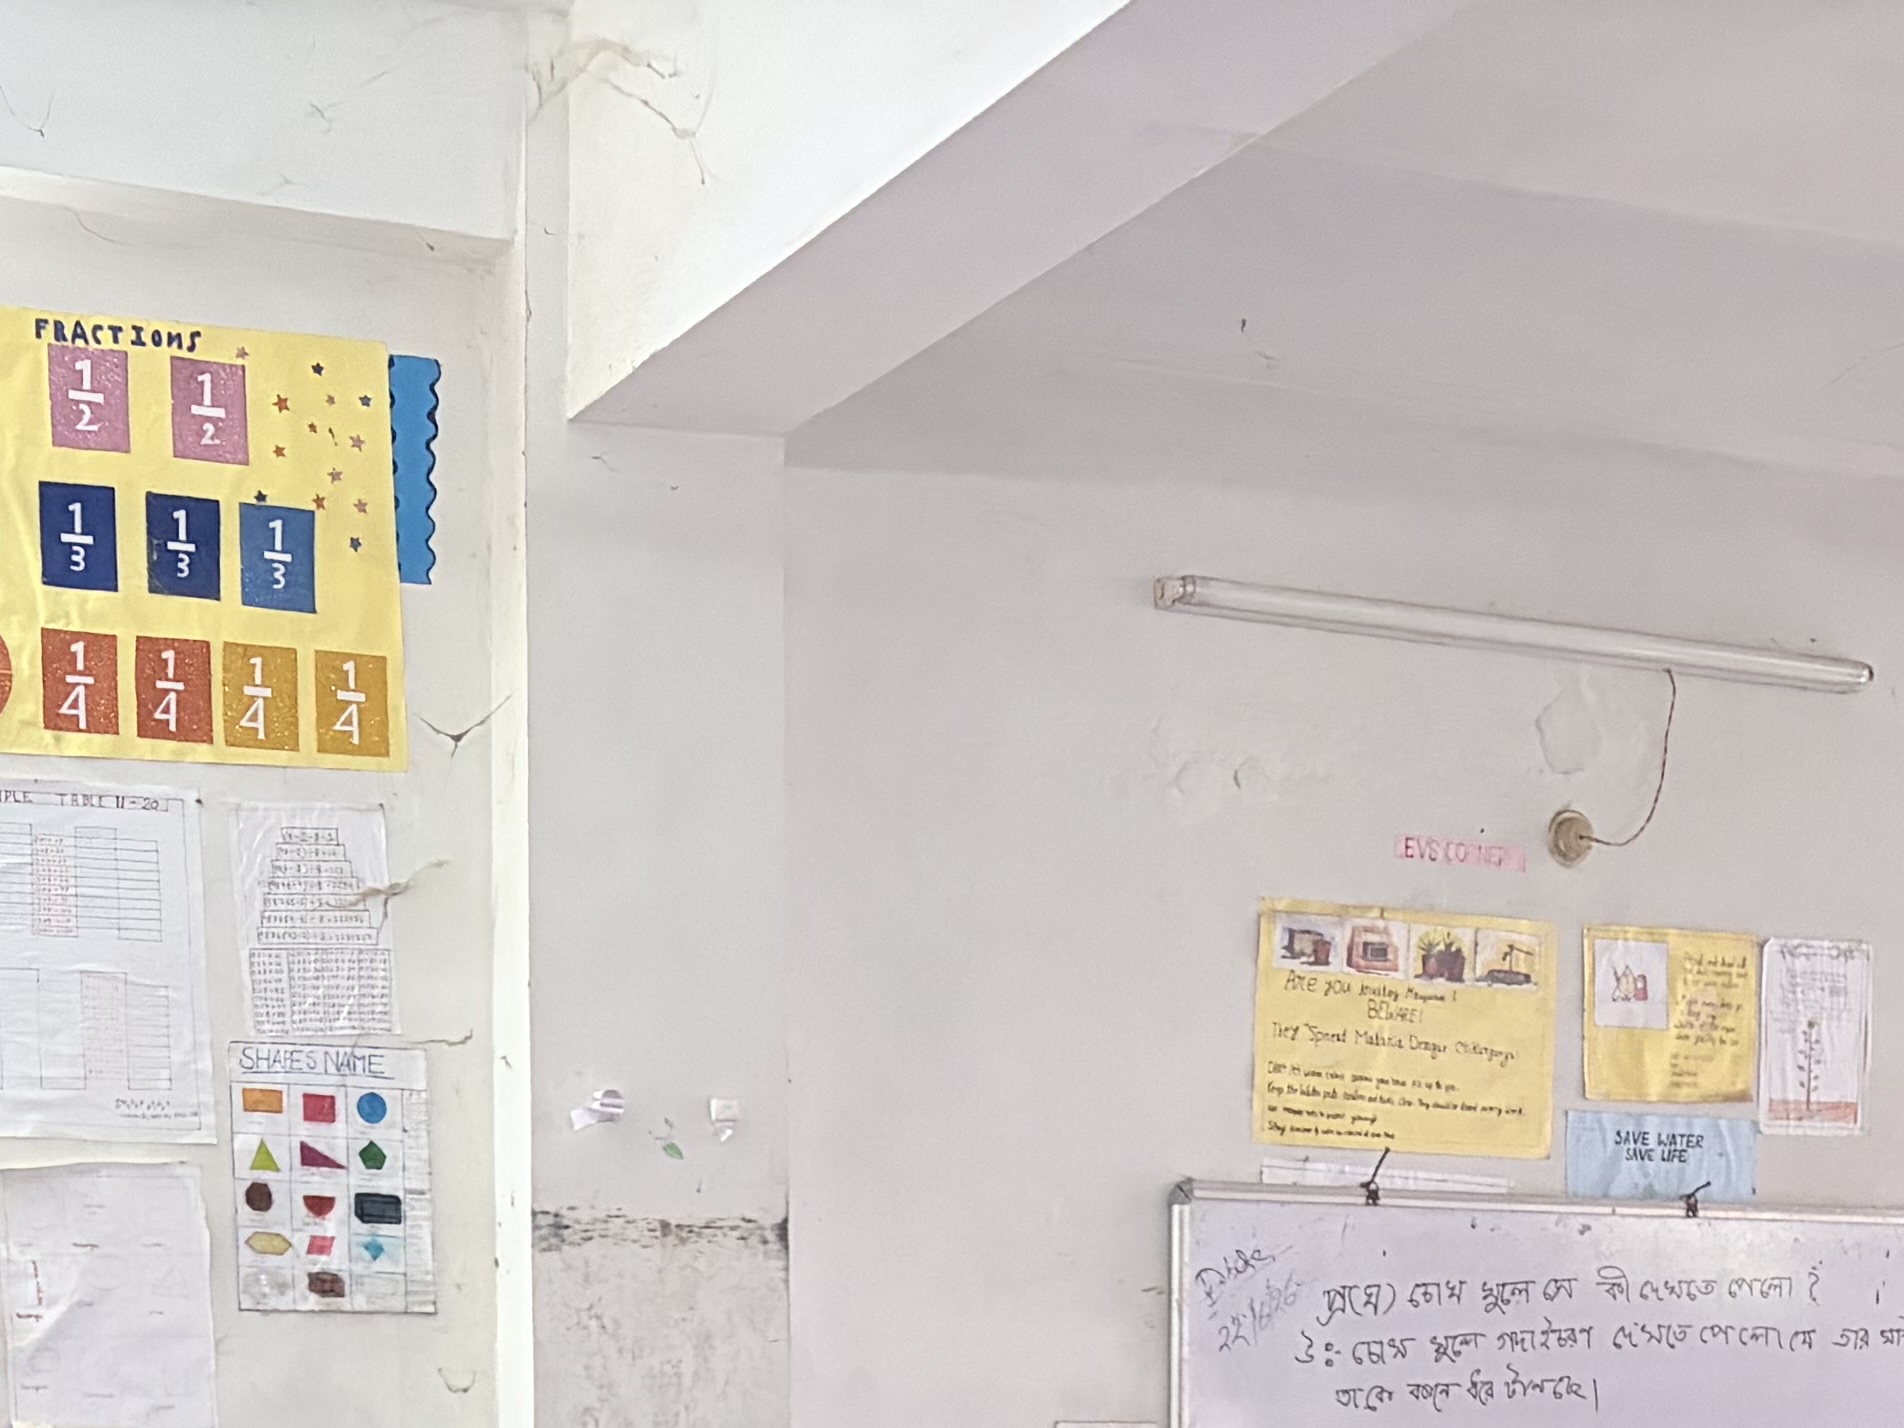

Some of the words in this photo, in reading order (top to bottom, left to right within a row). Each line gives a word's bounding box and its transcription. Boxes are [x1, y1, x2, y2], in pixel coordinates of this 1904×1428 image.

[34, 317, 204, 353] FRACTIONS
[1614, 1131, 1651, 1146] SAVE
[1656, 1132, 1704, 1149] WATER
[1625, 1147, 1655, 1162] SAVE
[1660, 1149, 1688, 1163] LIFE
[1595, 1265, 1631, 1303] কী
